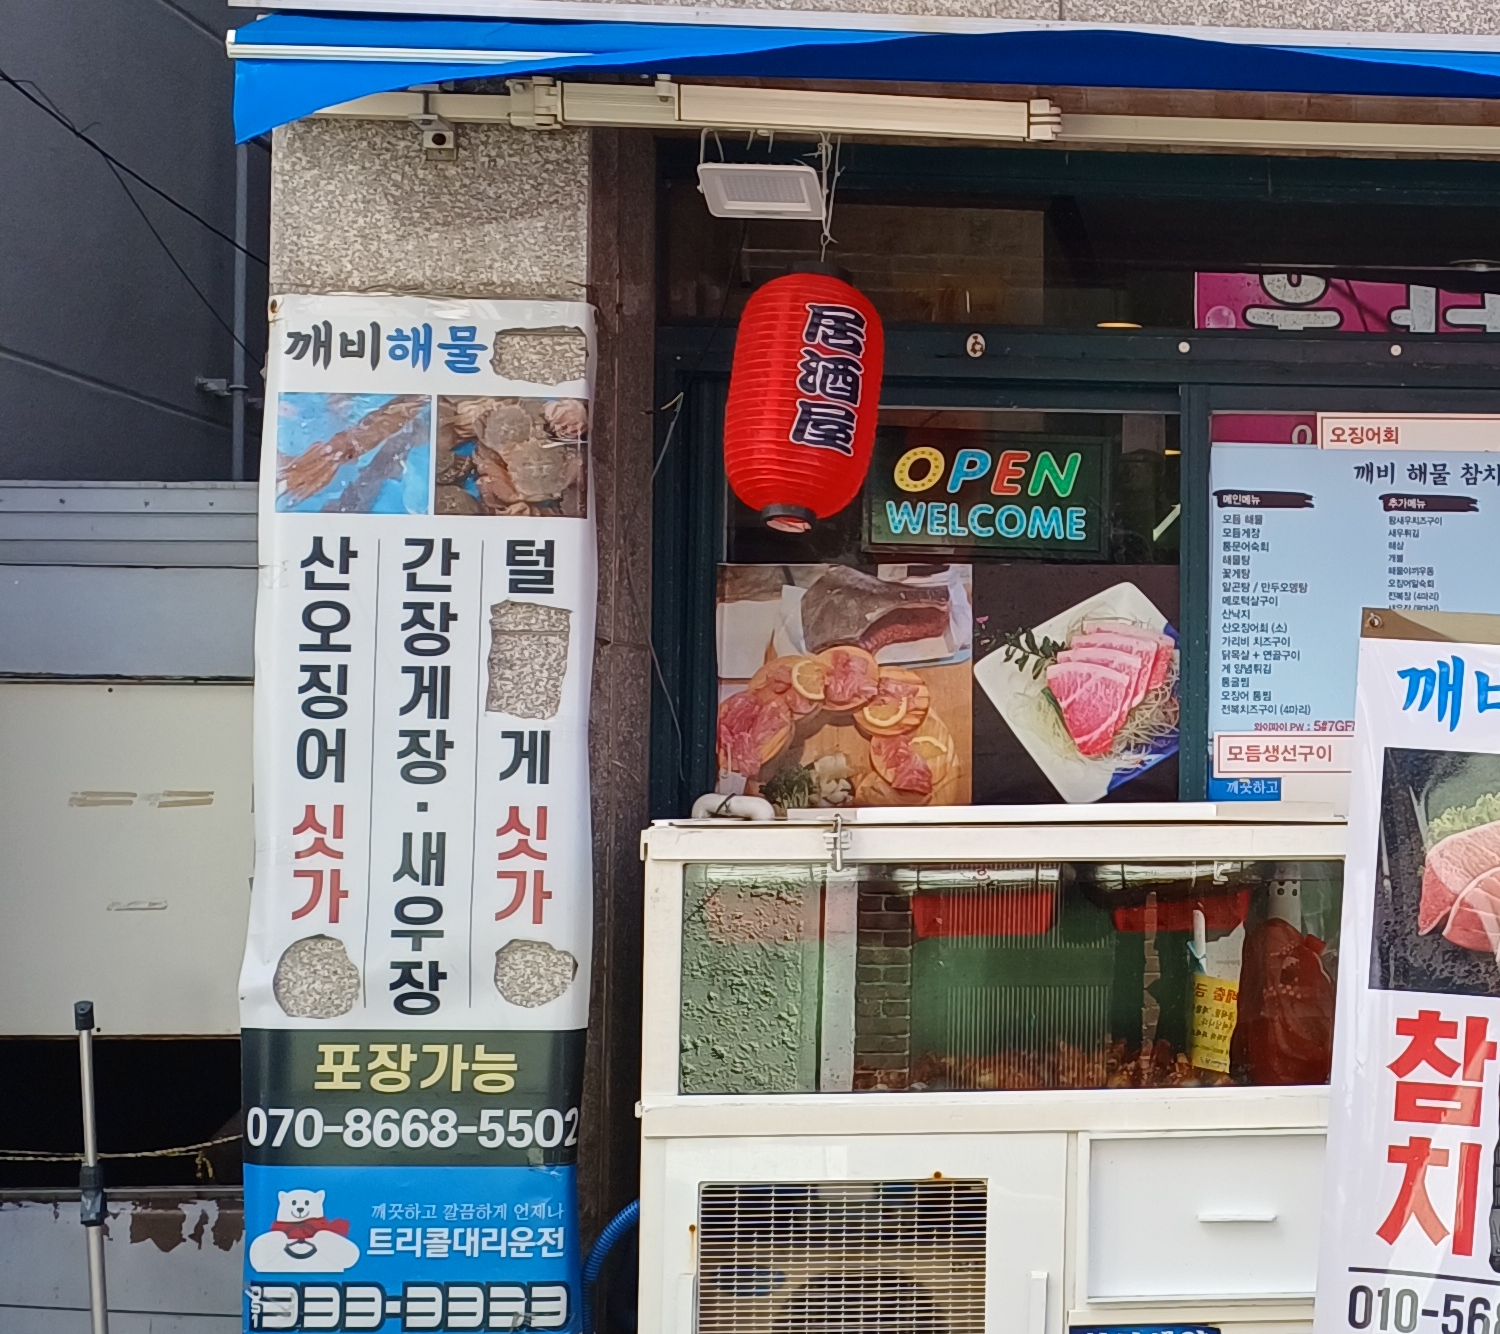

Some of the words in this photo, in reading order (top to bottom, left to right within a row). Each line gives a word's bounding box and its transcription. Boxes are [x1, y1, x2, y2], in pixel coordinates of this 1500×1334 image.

[284, 320, 488, 373] 깨비해물
[791, 303, 868, 456] 居酒屋
[1330, 426, 1400, 445] 오징어회
[893, 446, 1082, 498] OPEN
[1354, 461, 1396, 485] 깨비
[1406, 462, 1451, 486] 해물
[1222, 494, 1261, 505] 메인메뉴
[1388, 498, 1426, 509] 추가메뉴
[886, 500, 1087, 541] WELCOME
[1222, 609, 1250, 620] 산낙지
[1271, 623, 1288, 633] (소)
[1222, 636, 1249, 647] 가리비
[1253, 636, 1291, 647] 치즈구이
[296, 536, 359, 783] 산오징어
[1222, 664, 1231, 674] 게
[1221, 691, 1249, 701] 오징어
[1221, 704, 1277, 715] 전복치즈구이
[1227, 745, 1332, 763] 모듬생선구이
[291, 804, 349, 924] 싯가
[494, 805, 552, 925] 싯가
[314, 1044, 519, 1093] 포장가능
[246, 1107, 579, 1149] 070-8668-5502
[1376, 1009, 1498, 1257] 참치
[372, 1203, 437, 1221] 깨끗하고
[443, 1202, 508, 1222] 깔끔하게
[513, 1202, 565, 1221] 언제나
[366, 1227, 565, 1259] 트리콜대리운전
[262, 1286, 568, 1329] 333-3333
